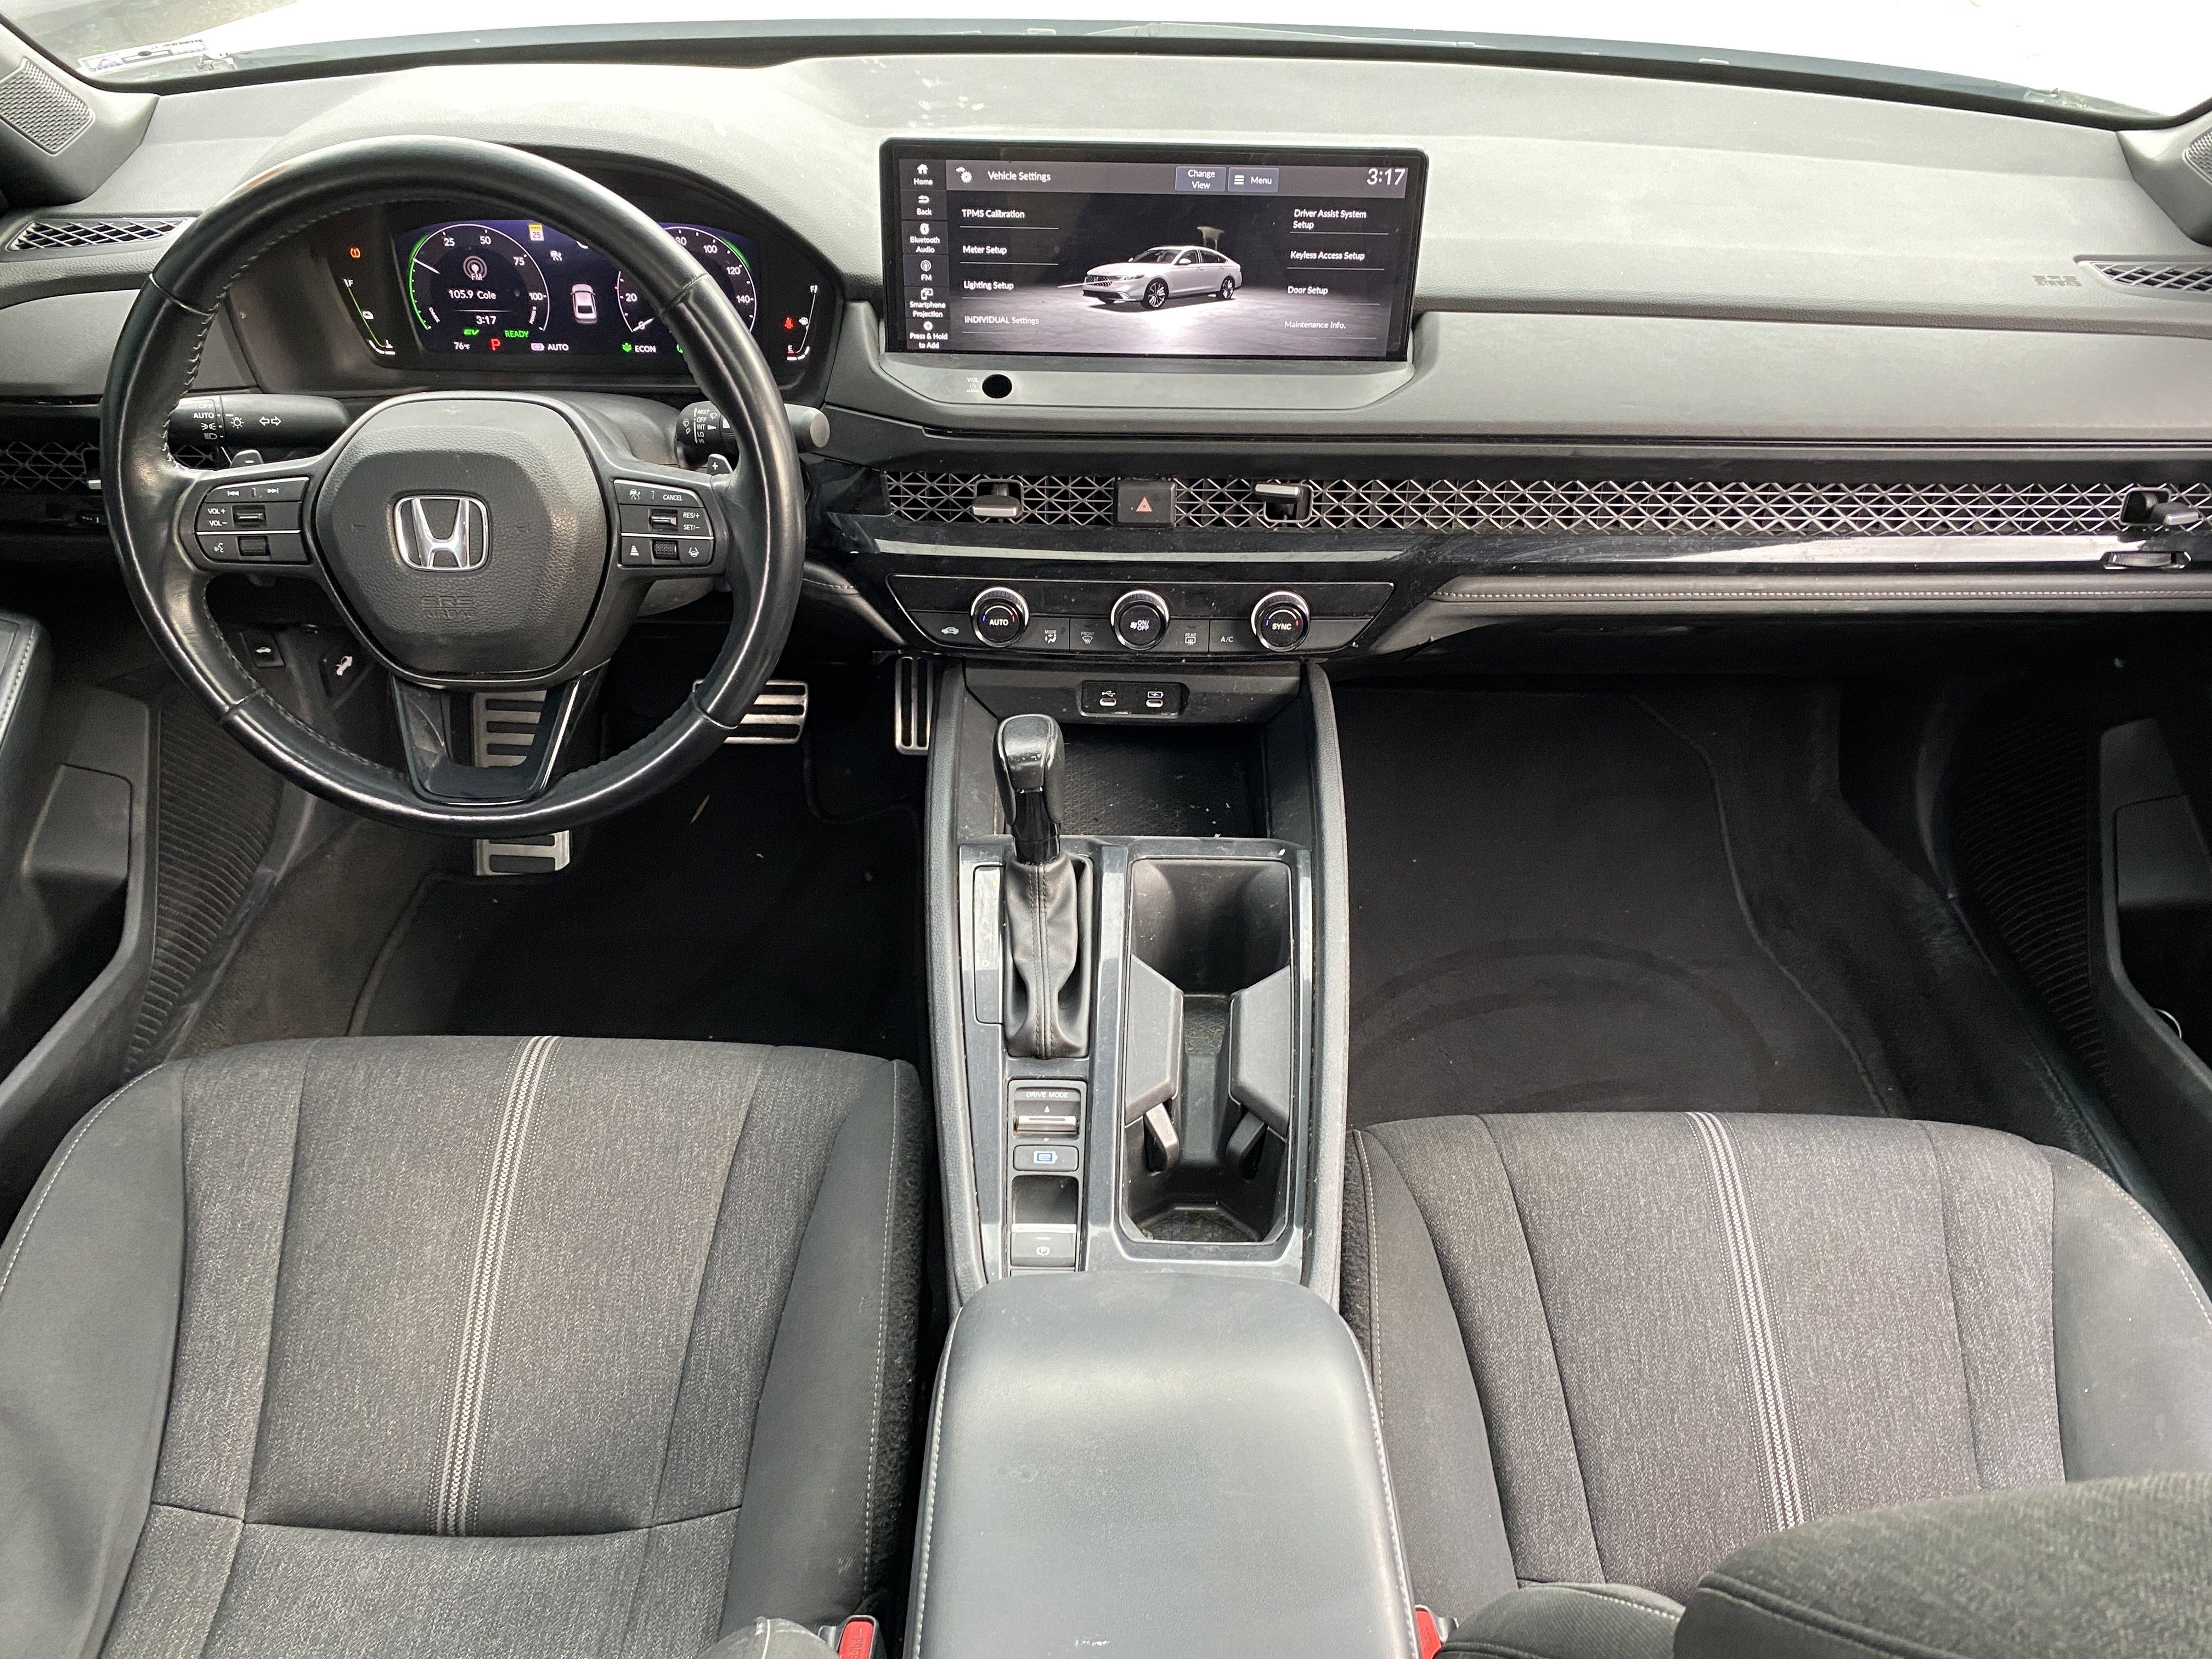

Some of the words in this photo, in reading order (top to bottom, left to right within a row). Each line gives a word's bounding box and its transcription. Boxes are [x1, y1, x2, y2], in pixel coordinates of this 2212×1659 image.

[988, 171, 1017, 180] Vehicle
[1019, 172, 1051, 182] Settings
[1188, 169, 1216, 178] Change
[1367, 168, 1406, 185] 3:17
[1251, 176, 1272, 184] Menu
[1192, 181, 1210, 189] View
[962, 209, 984, 218] TPMS
[985, 210, 1025, 218] Calibration
[1294, 209, 1317, 218] Driver
[1318, 210, 1339, 218] Assist
[1340, 210, 1367, 219] System
[1293, 221, 1314, 230] Setup
[444, 238, 455, 246] 25
[480, 236, 491, 245] 50
[703, 245, 717, 254] 100
[962, 246, 984, 254] Meter
[986, 246, 1007, 255] Setup
[1290, 251, 1317, 260] Keyless
[1318, 251, 1342, 260] Access
[1344, 251, 1365, 261] Setup
[514, 257, 525, 266] 75
[726, 267, 741, 275] 120
[963, 281, 991, 290] Lighting
[992, 281, 1014, 291] Setup
[449, 290, 473, 299] 105.9
[477, 291, 496, 300] Cole
[1288, 286, 1305, 295] Door
[1307, 286, 1328, 296] Setup
[529, 292, 543, 301] 100
[625, 294, 637, 302] 20
[736, 295, 750, 303] 140
[910, 301, 946, 309] Smartphone
[476, 315, 496, 325] 3:17
[1012, 317, 1039, 326] Settings
[490, 339, 500, 351] P
